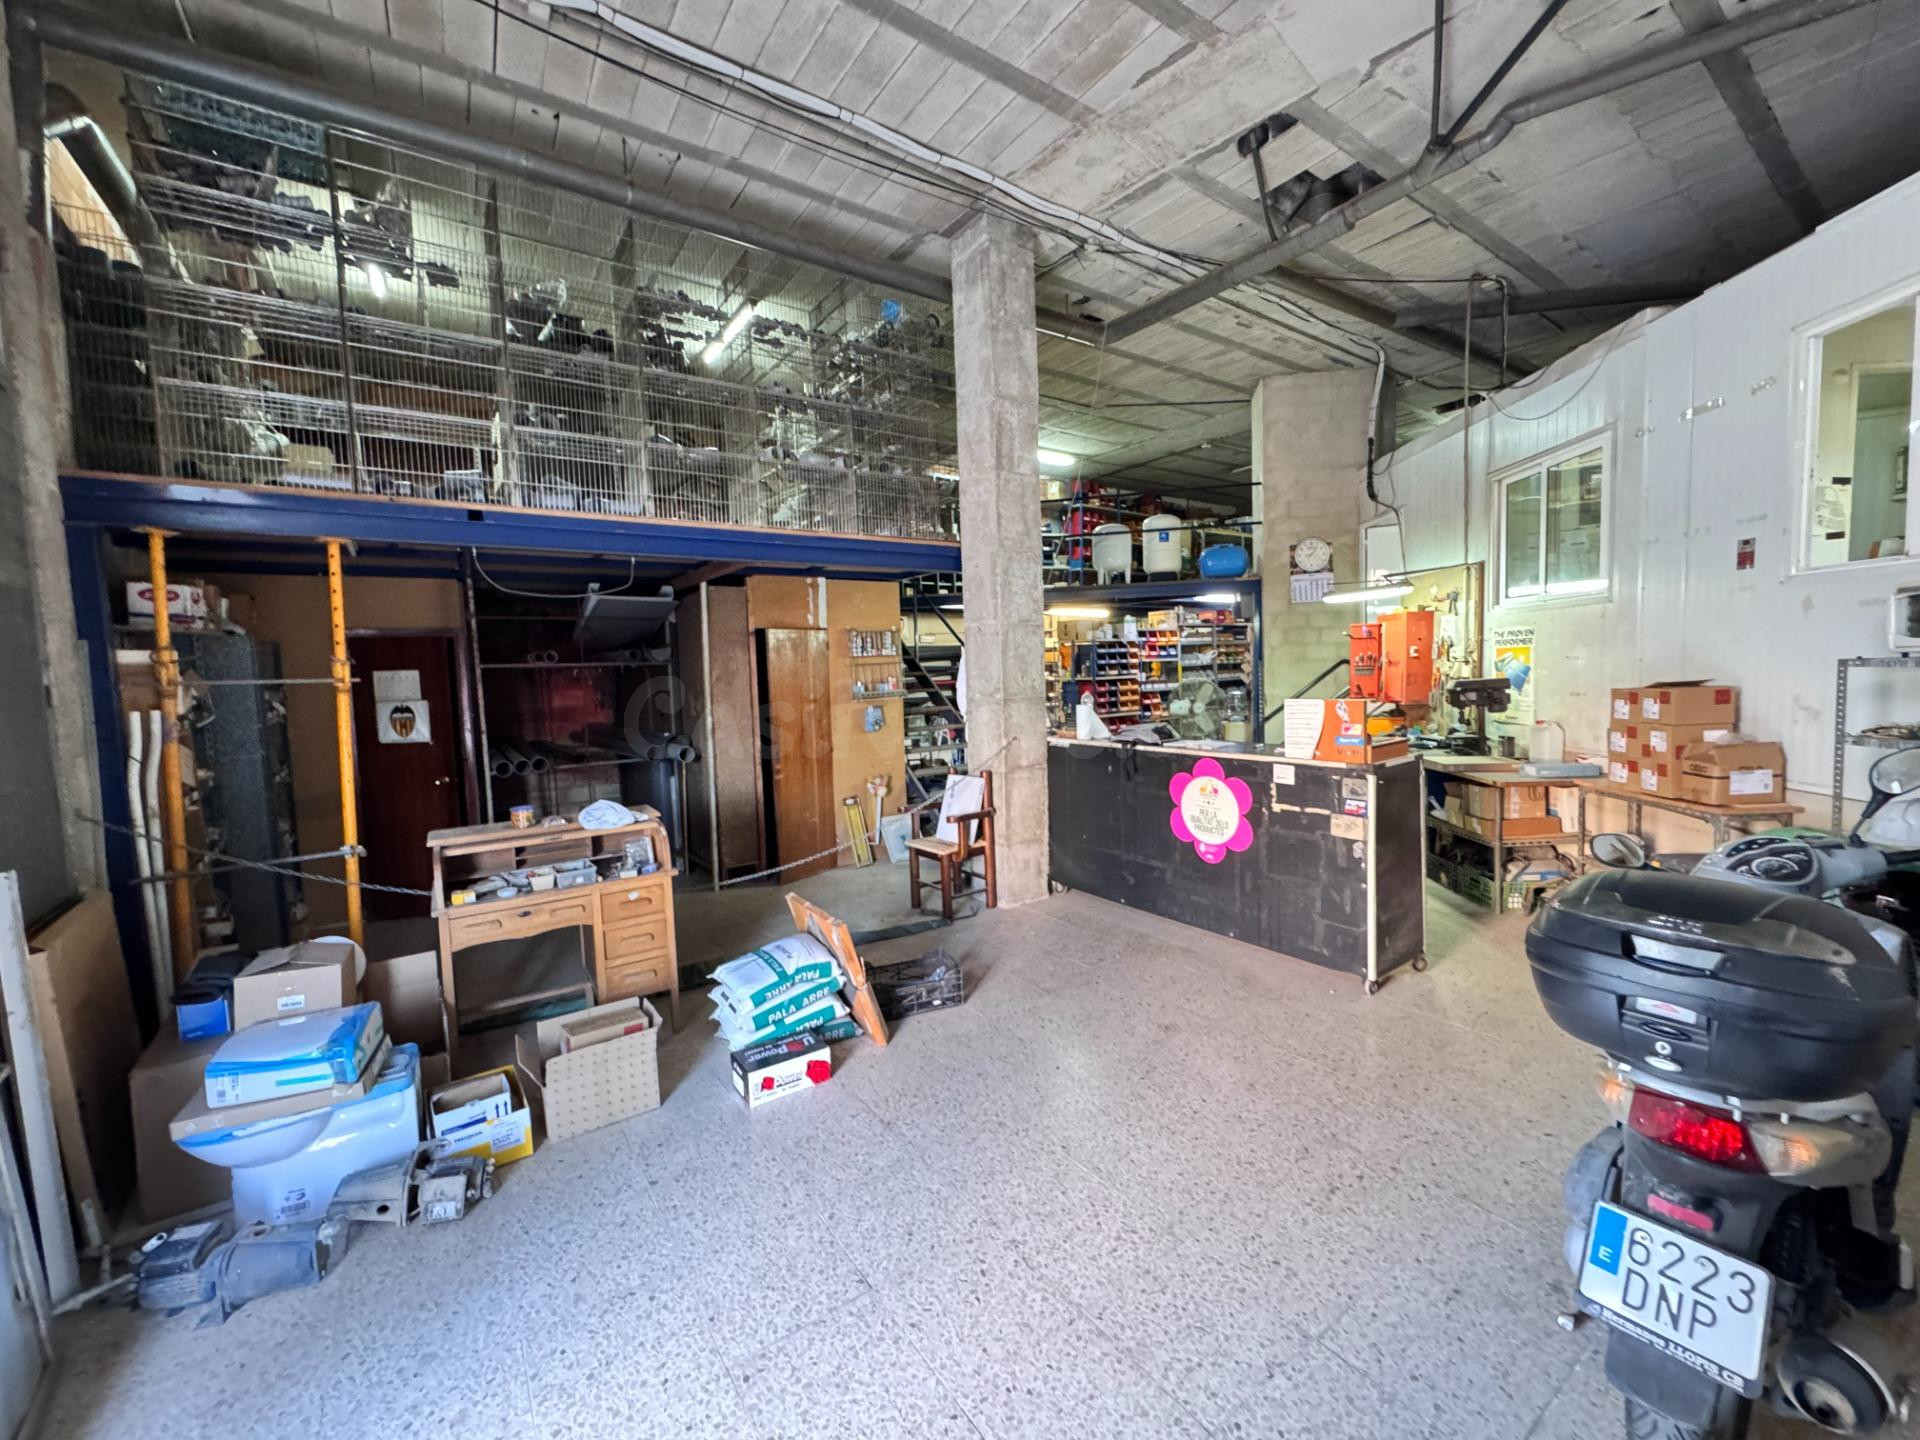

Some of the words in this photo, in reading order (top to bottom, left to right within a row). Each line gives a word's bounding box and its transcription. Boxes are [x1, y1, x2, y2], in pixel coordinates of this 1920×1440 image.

[768, 1003, 797, 1025] PALA
[1598, 1245, 1613, 1263] E
[1628, 1227, 1756, 1314] 6223
[1622, 1268, 1717, 1339] DNP
